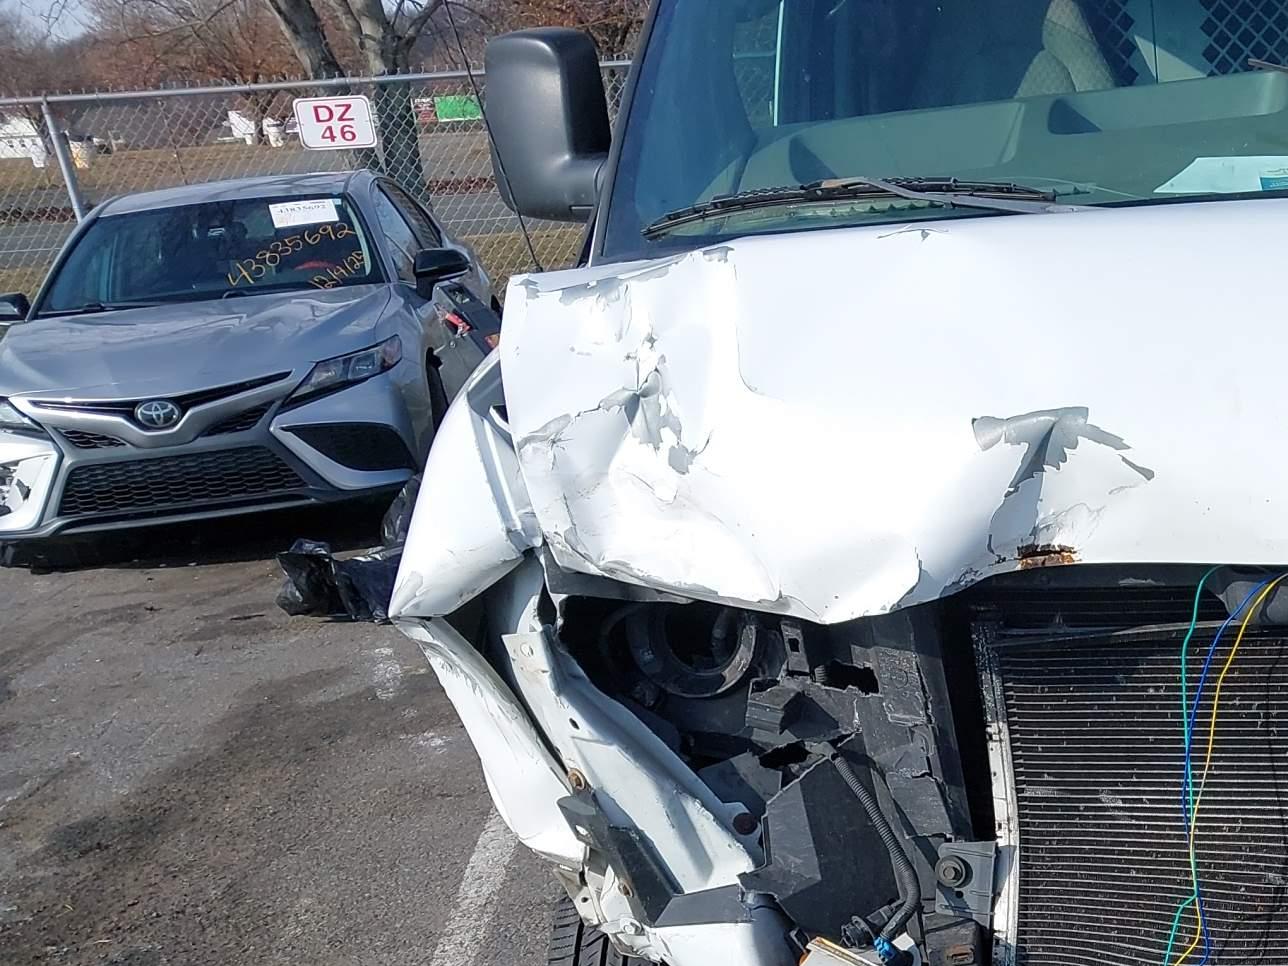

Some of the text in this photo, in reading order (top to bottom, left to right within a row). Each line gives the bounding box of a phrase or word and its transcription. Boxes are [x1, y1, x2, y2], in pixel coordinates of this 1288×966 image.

[312, 103, 355, 123] DZ
[321, 124, 357, 143] 46
[227, 222, 357, 287] 43835692
